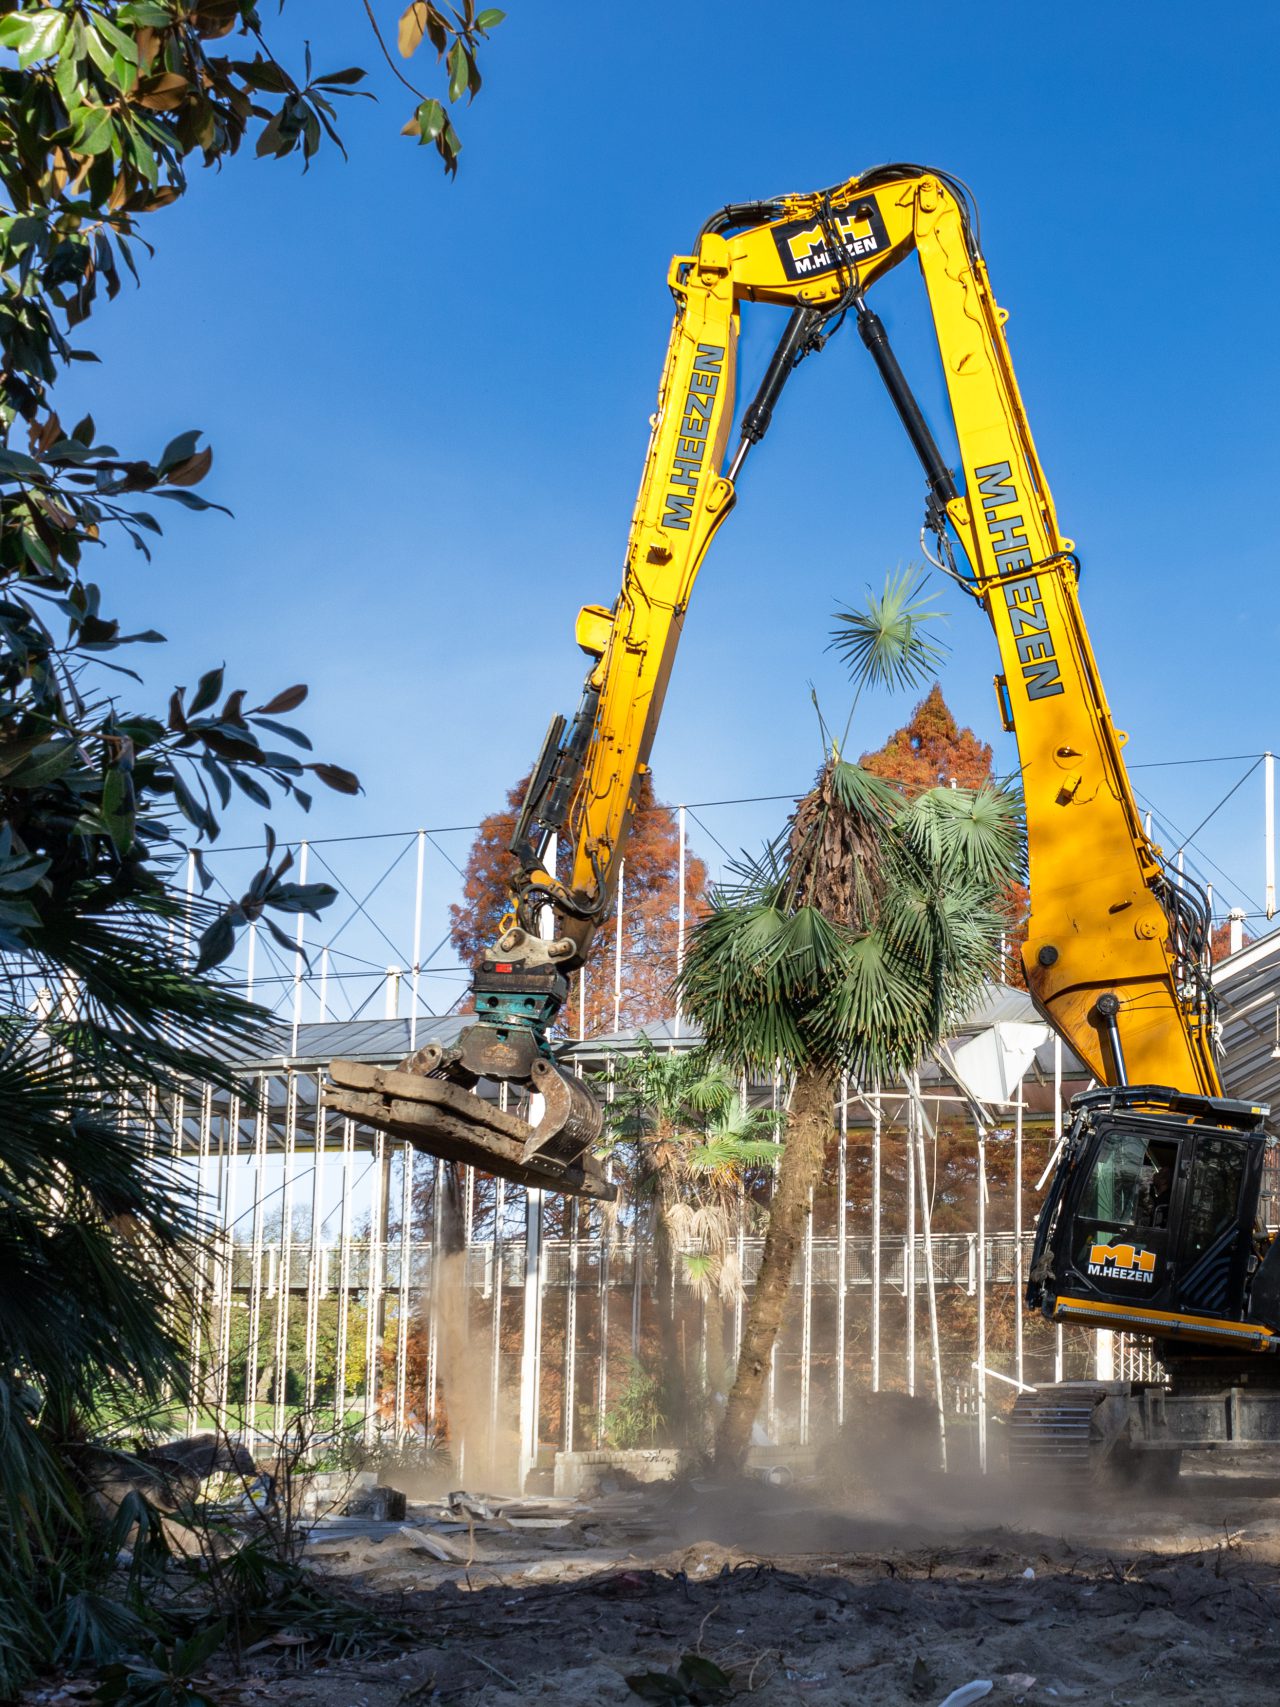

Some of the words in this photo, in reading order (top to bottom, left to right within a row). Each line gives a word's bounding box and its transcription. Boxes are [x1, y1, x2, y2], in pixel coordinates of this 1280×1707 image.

[661, 343, 725, 531] M.HEEZEN
[974, 460, 1065, 702] M.HEEZEN
[1087, 1264, 1154, 1284] M.HEEZEN
